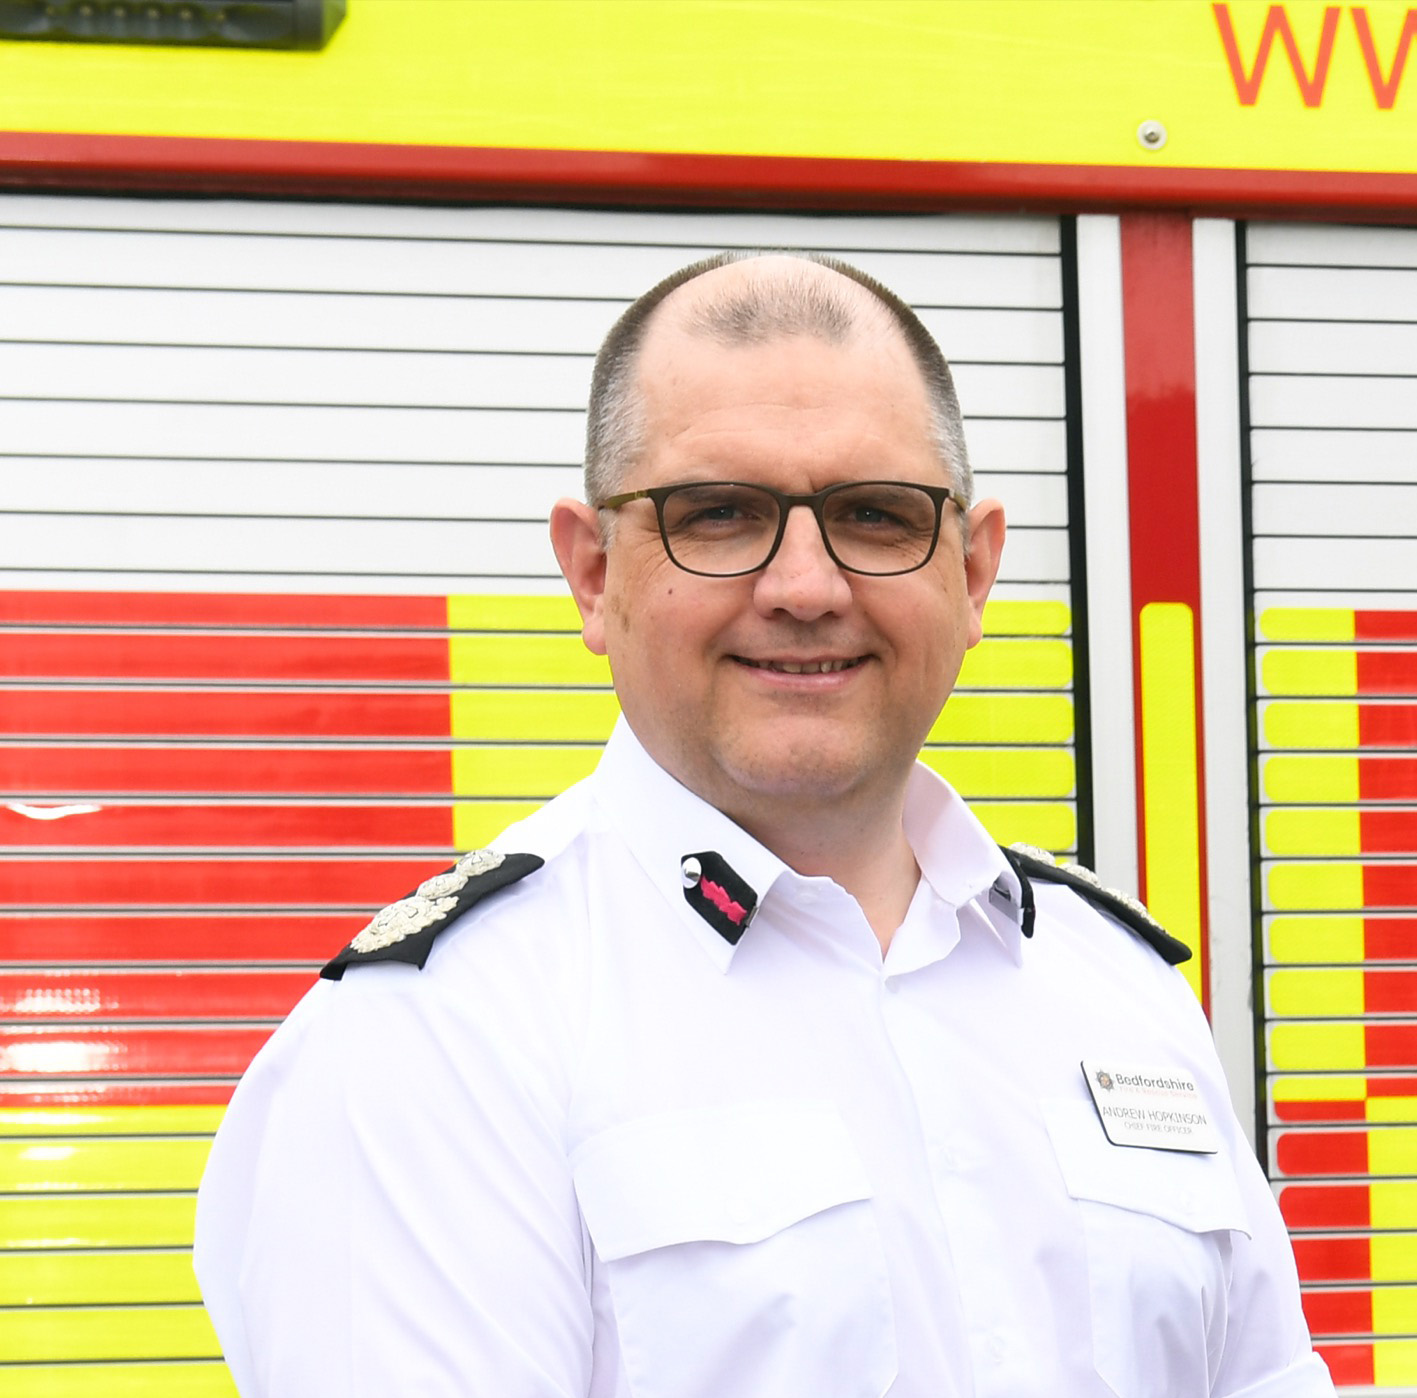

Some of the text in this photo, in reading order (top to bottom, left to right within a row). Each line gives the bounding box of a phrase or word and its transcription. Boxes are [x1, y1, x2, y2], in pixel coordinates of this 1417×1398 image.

[1115, 1073, 1194, 1091] Bedfordshire
[1102, 1106, 1207, 1125] ANDREW HOPKINSON
